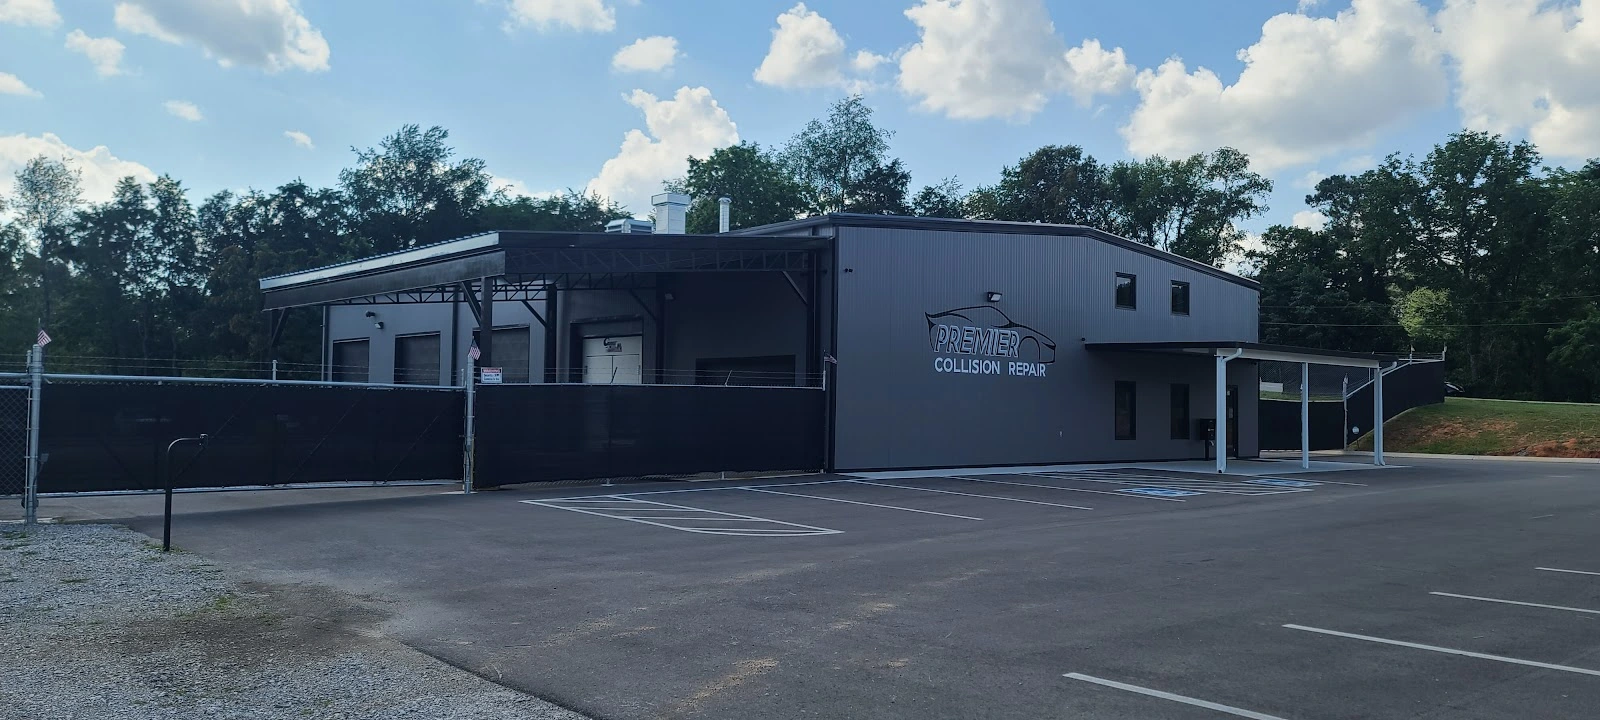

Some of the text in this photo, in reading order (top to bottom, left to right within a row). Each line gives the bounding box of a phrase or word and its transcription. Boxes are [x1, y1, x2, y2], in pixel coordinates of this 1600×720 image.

[934, 324, 1020, 358] PREMIER
[934, 357, 1046, 377] COLLISION REPAIR
